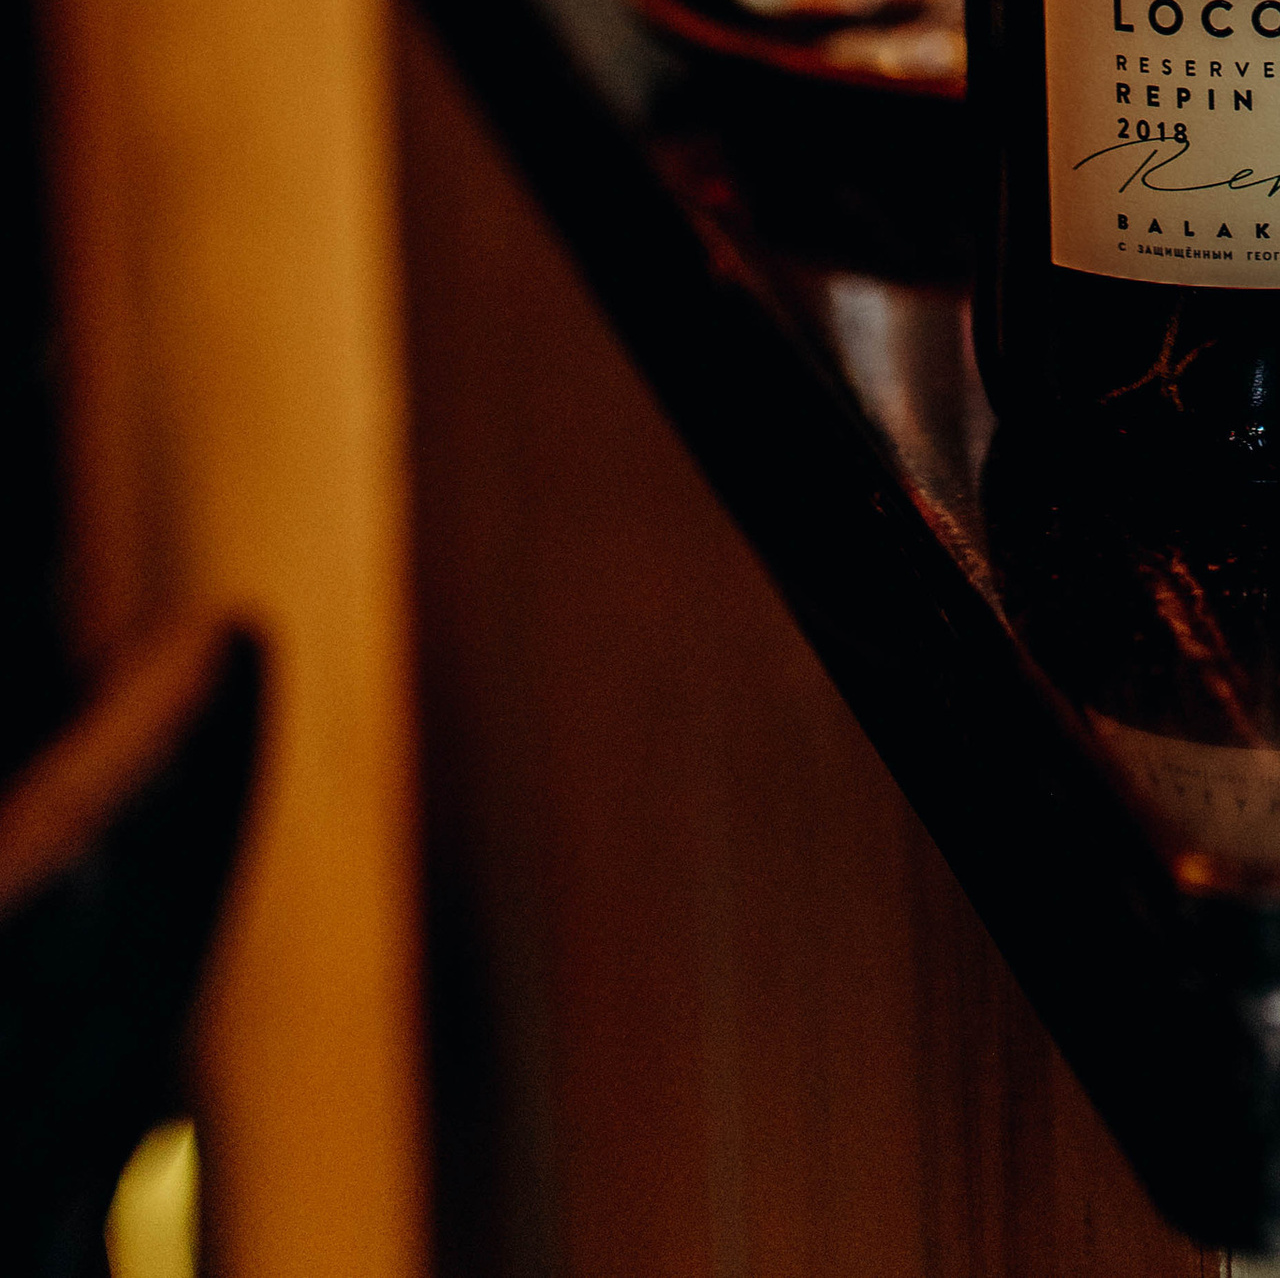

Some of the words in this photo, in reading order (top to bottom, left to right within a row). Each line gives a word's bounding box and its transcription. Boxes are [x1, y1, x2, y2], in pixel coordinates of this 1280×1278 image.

[1115, 55, 1276, 78] RESERVE
[1115, 83, 1254, 111] REPIN
[1116, 118, 1188, 144] 2018
[1137, 244, 1233, 260] ЗАЩИЩЁННЫМ
